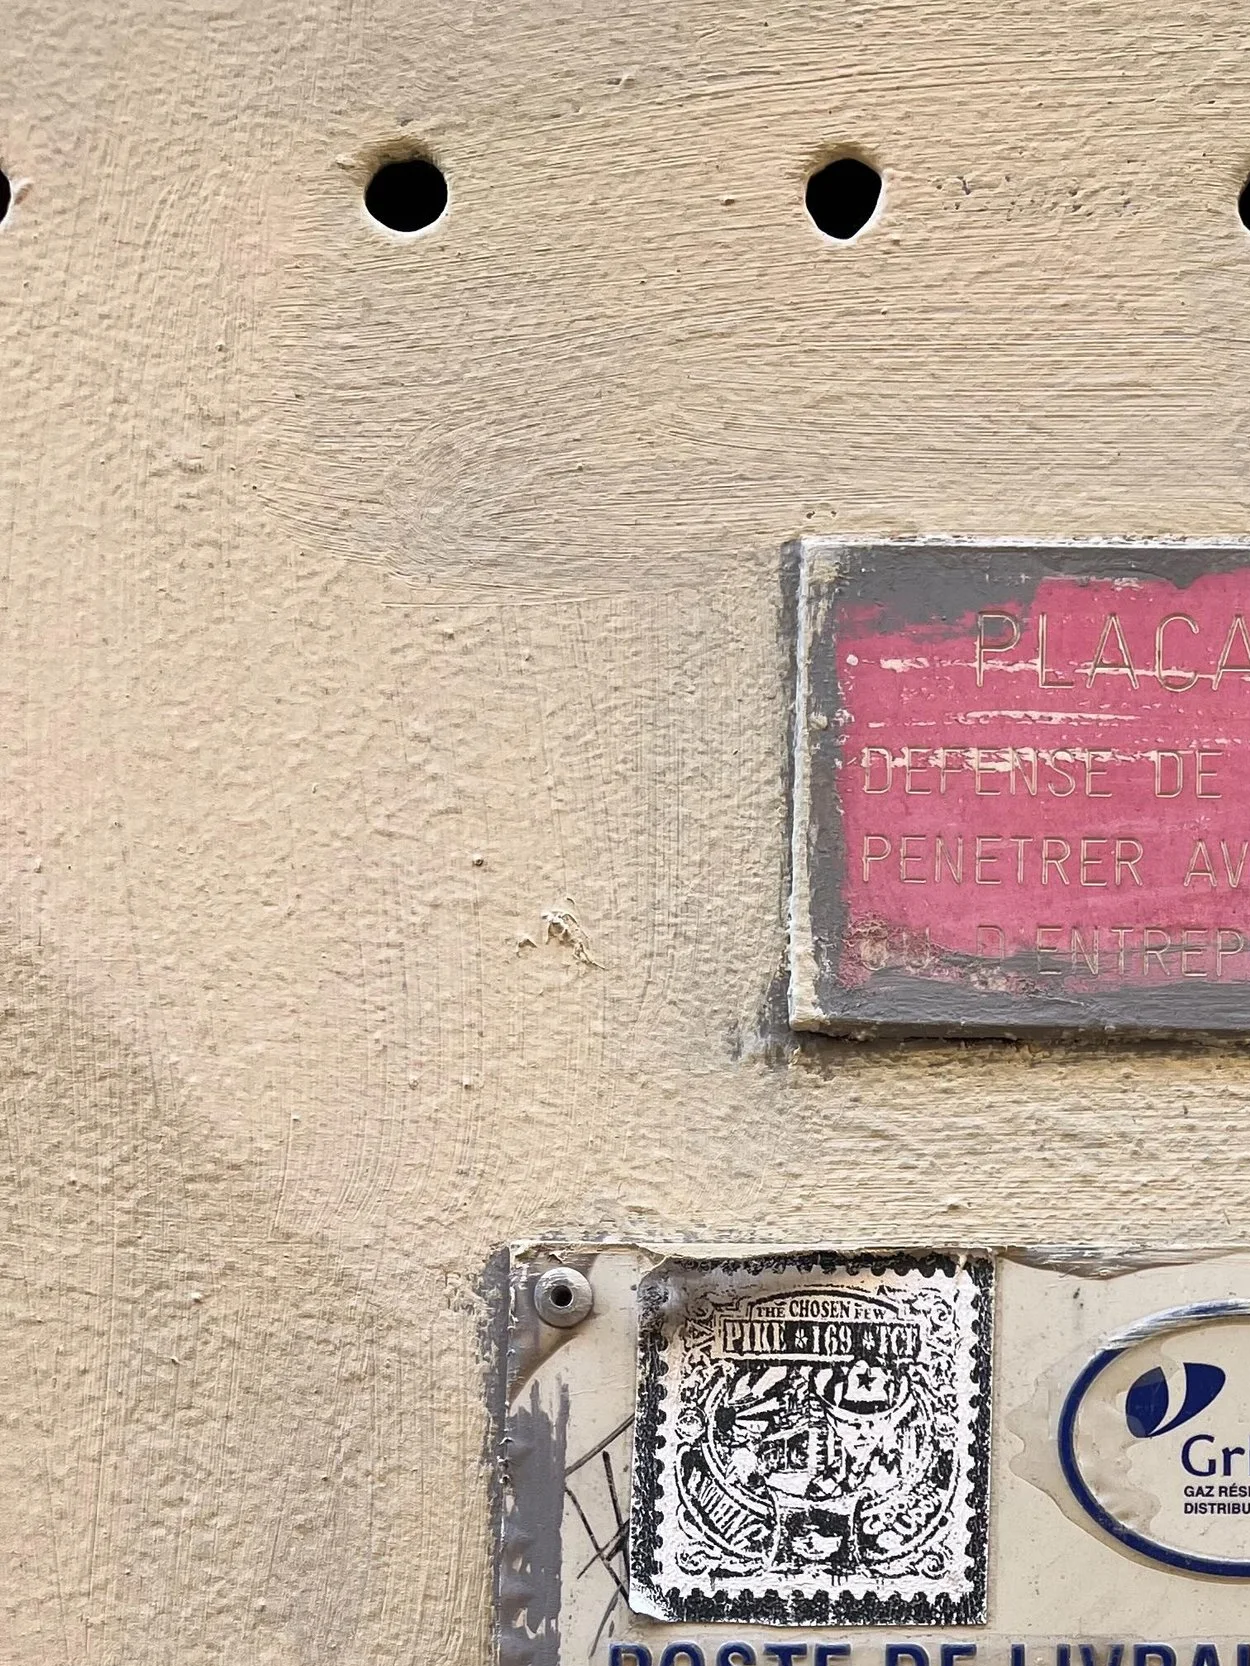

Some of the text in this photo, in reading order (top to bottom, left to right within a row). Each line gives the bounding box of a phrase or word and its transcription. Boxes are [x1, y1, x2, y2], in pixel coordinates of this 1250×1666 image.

[861, 746, 1113, 798] DEFENSE
[1153, 749, 1223, 799] DE
[861, 834, 1144, 888] PENETRER
[756, 1299, 887, 1320] THE CHOSEN FEW
[811, 1324, 852, 1356] 169
[1183, 1485, 1215, 1499] GAZ
